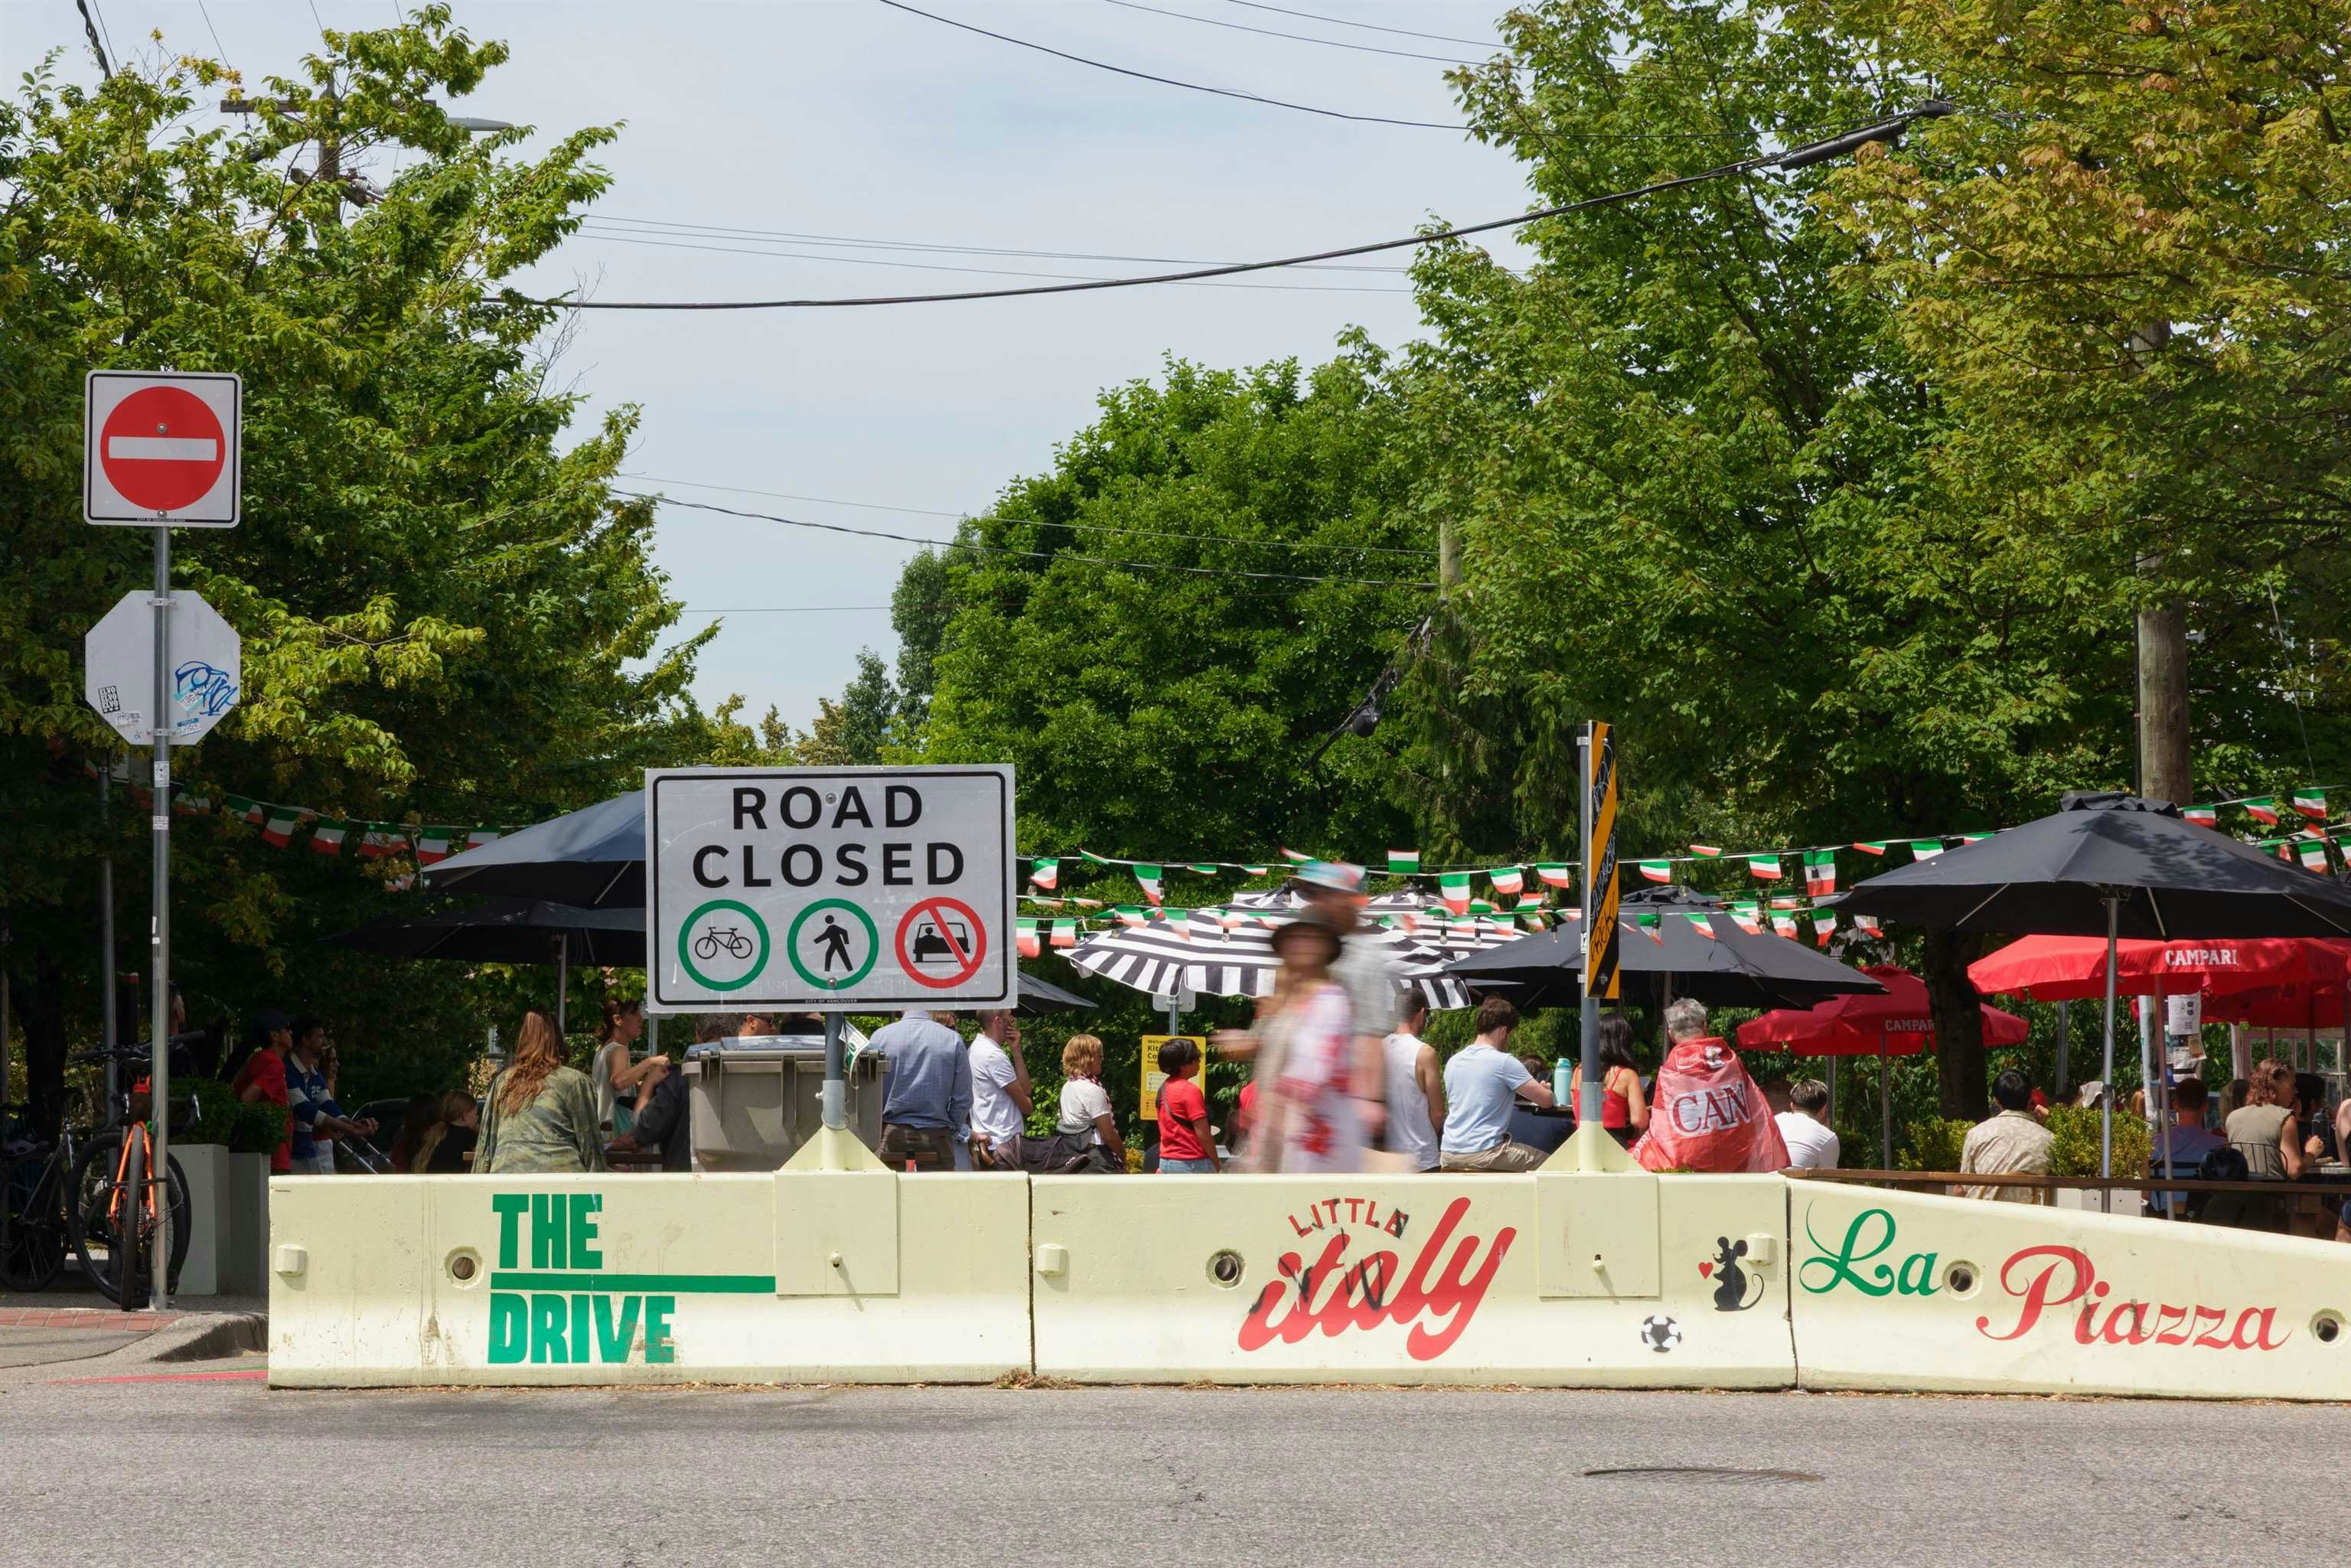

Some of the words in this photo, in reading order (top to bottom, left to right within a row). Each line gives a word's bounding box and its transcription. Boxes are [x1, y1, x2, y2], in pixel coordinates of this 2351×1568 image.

[99, 686, 116, 695] ELVO
[101, 693, 118, 703] ELVO
[103, 700, 119, 710] ELVO
[732, 784, 923, 830] ROAD
[693, 842, 964, 889] CLOSED
[2165, 949, 2238, 966] CAMPARI
[1885, 1019, 1935, 1032] CAMPAR
[1672, 1082, 1751, 1133] CAN
[492, 1193, 603, 1270] THE
[1799, 1199, 1942, 1296] La
[1976, 1244, 2293, 1351] Piazza
[487, 1292, 676, 1364] DRIVE
